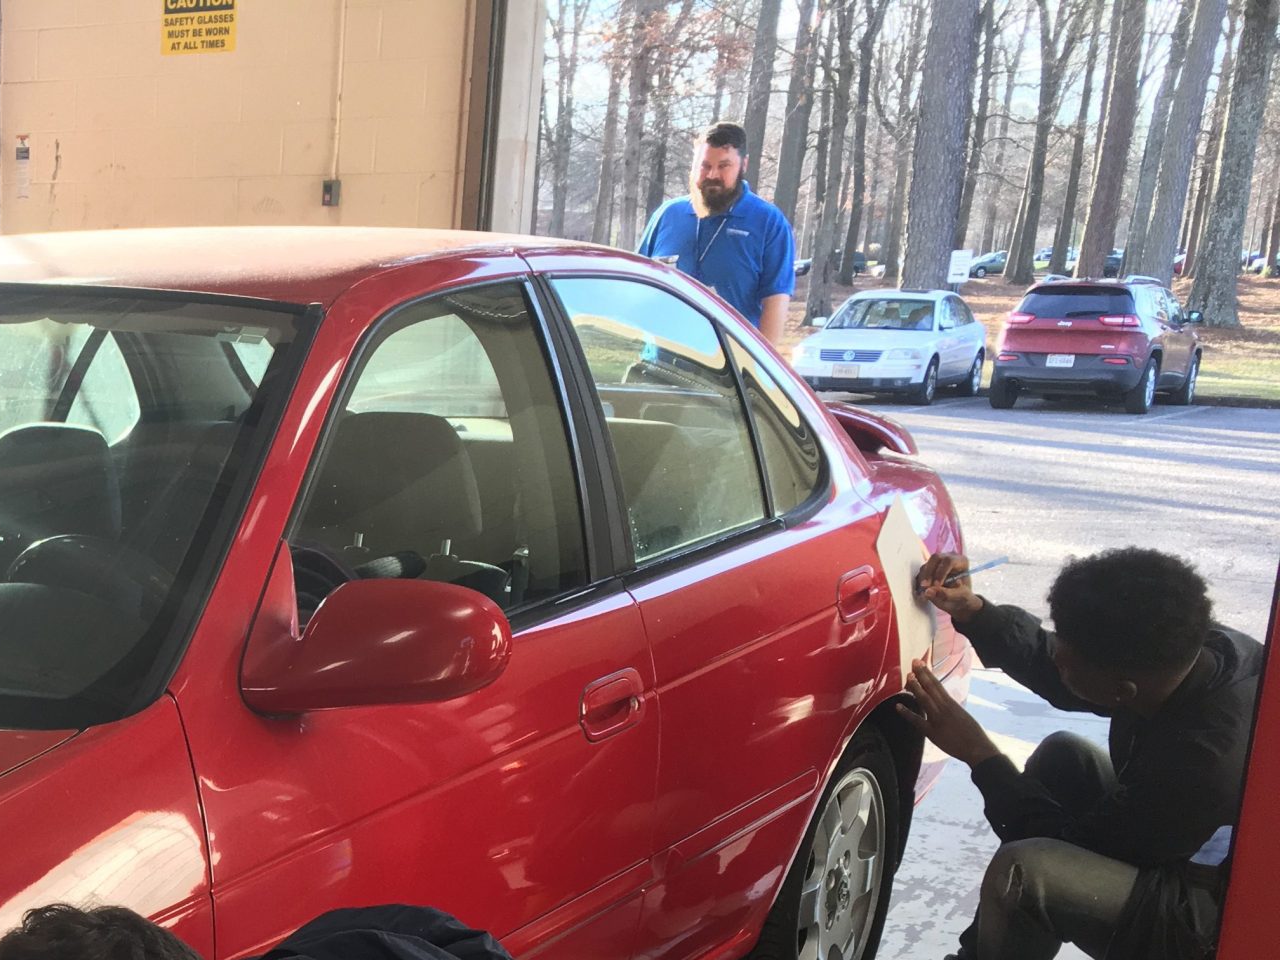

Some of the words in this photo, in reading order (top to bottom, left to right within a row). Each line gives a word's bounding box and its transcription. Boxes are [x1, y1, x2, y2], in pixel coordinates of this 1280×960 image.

[164, 16, 195, 27] SAFETY
[197, 14, 234, 24] GLASSES
[167, 29, 190, 39] MUST
[192, 28, 203, 37] BE
[205, 26, 230, 36] WORN
[170, 41, 181, 51] AT
[183, 41, 198, 50] ALL
[200, 39, 225, 49] TIMES
